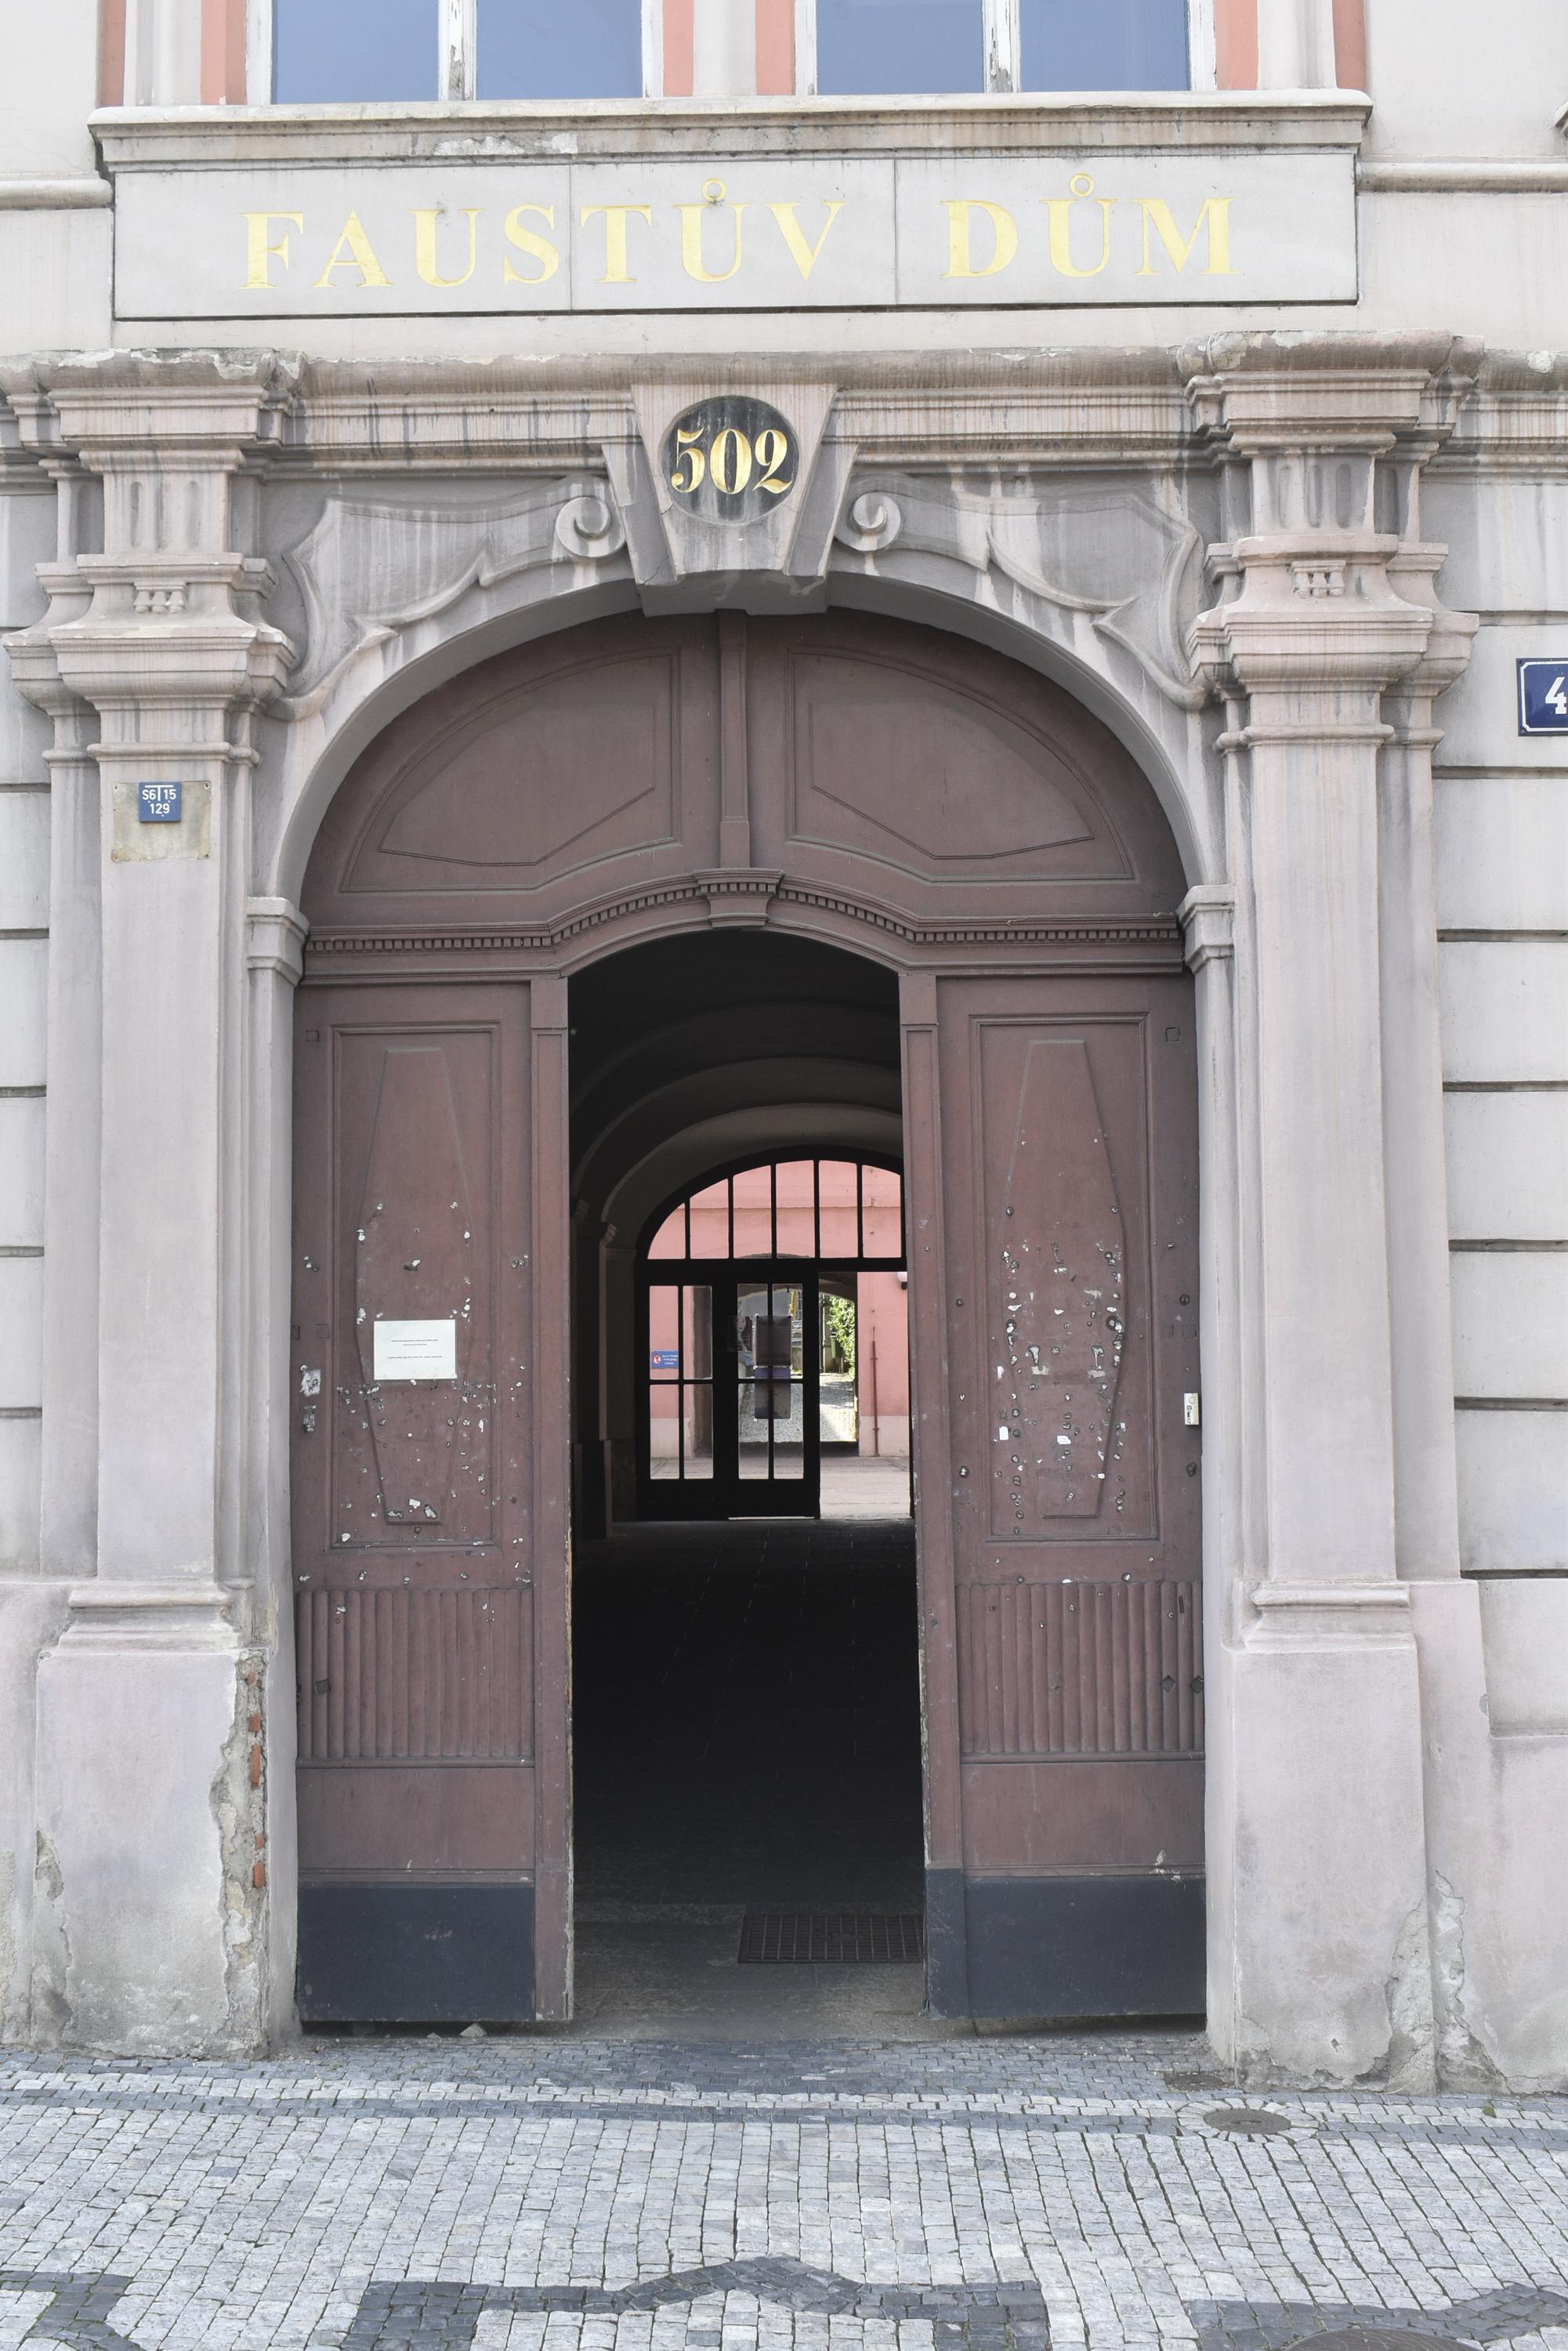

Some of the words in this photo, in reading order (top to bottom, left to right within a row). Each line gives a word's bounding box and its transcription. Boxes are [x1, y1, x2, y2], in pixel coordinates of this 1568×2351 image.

[237, 177, 847, 289] FAUSTŮV
[940, 172, 1237, 279] DŮM
[671, 427, 793, 494] 502
